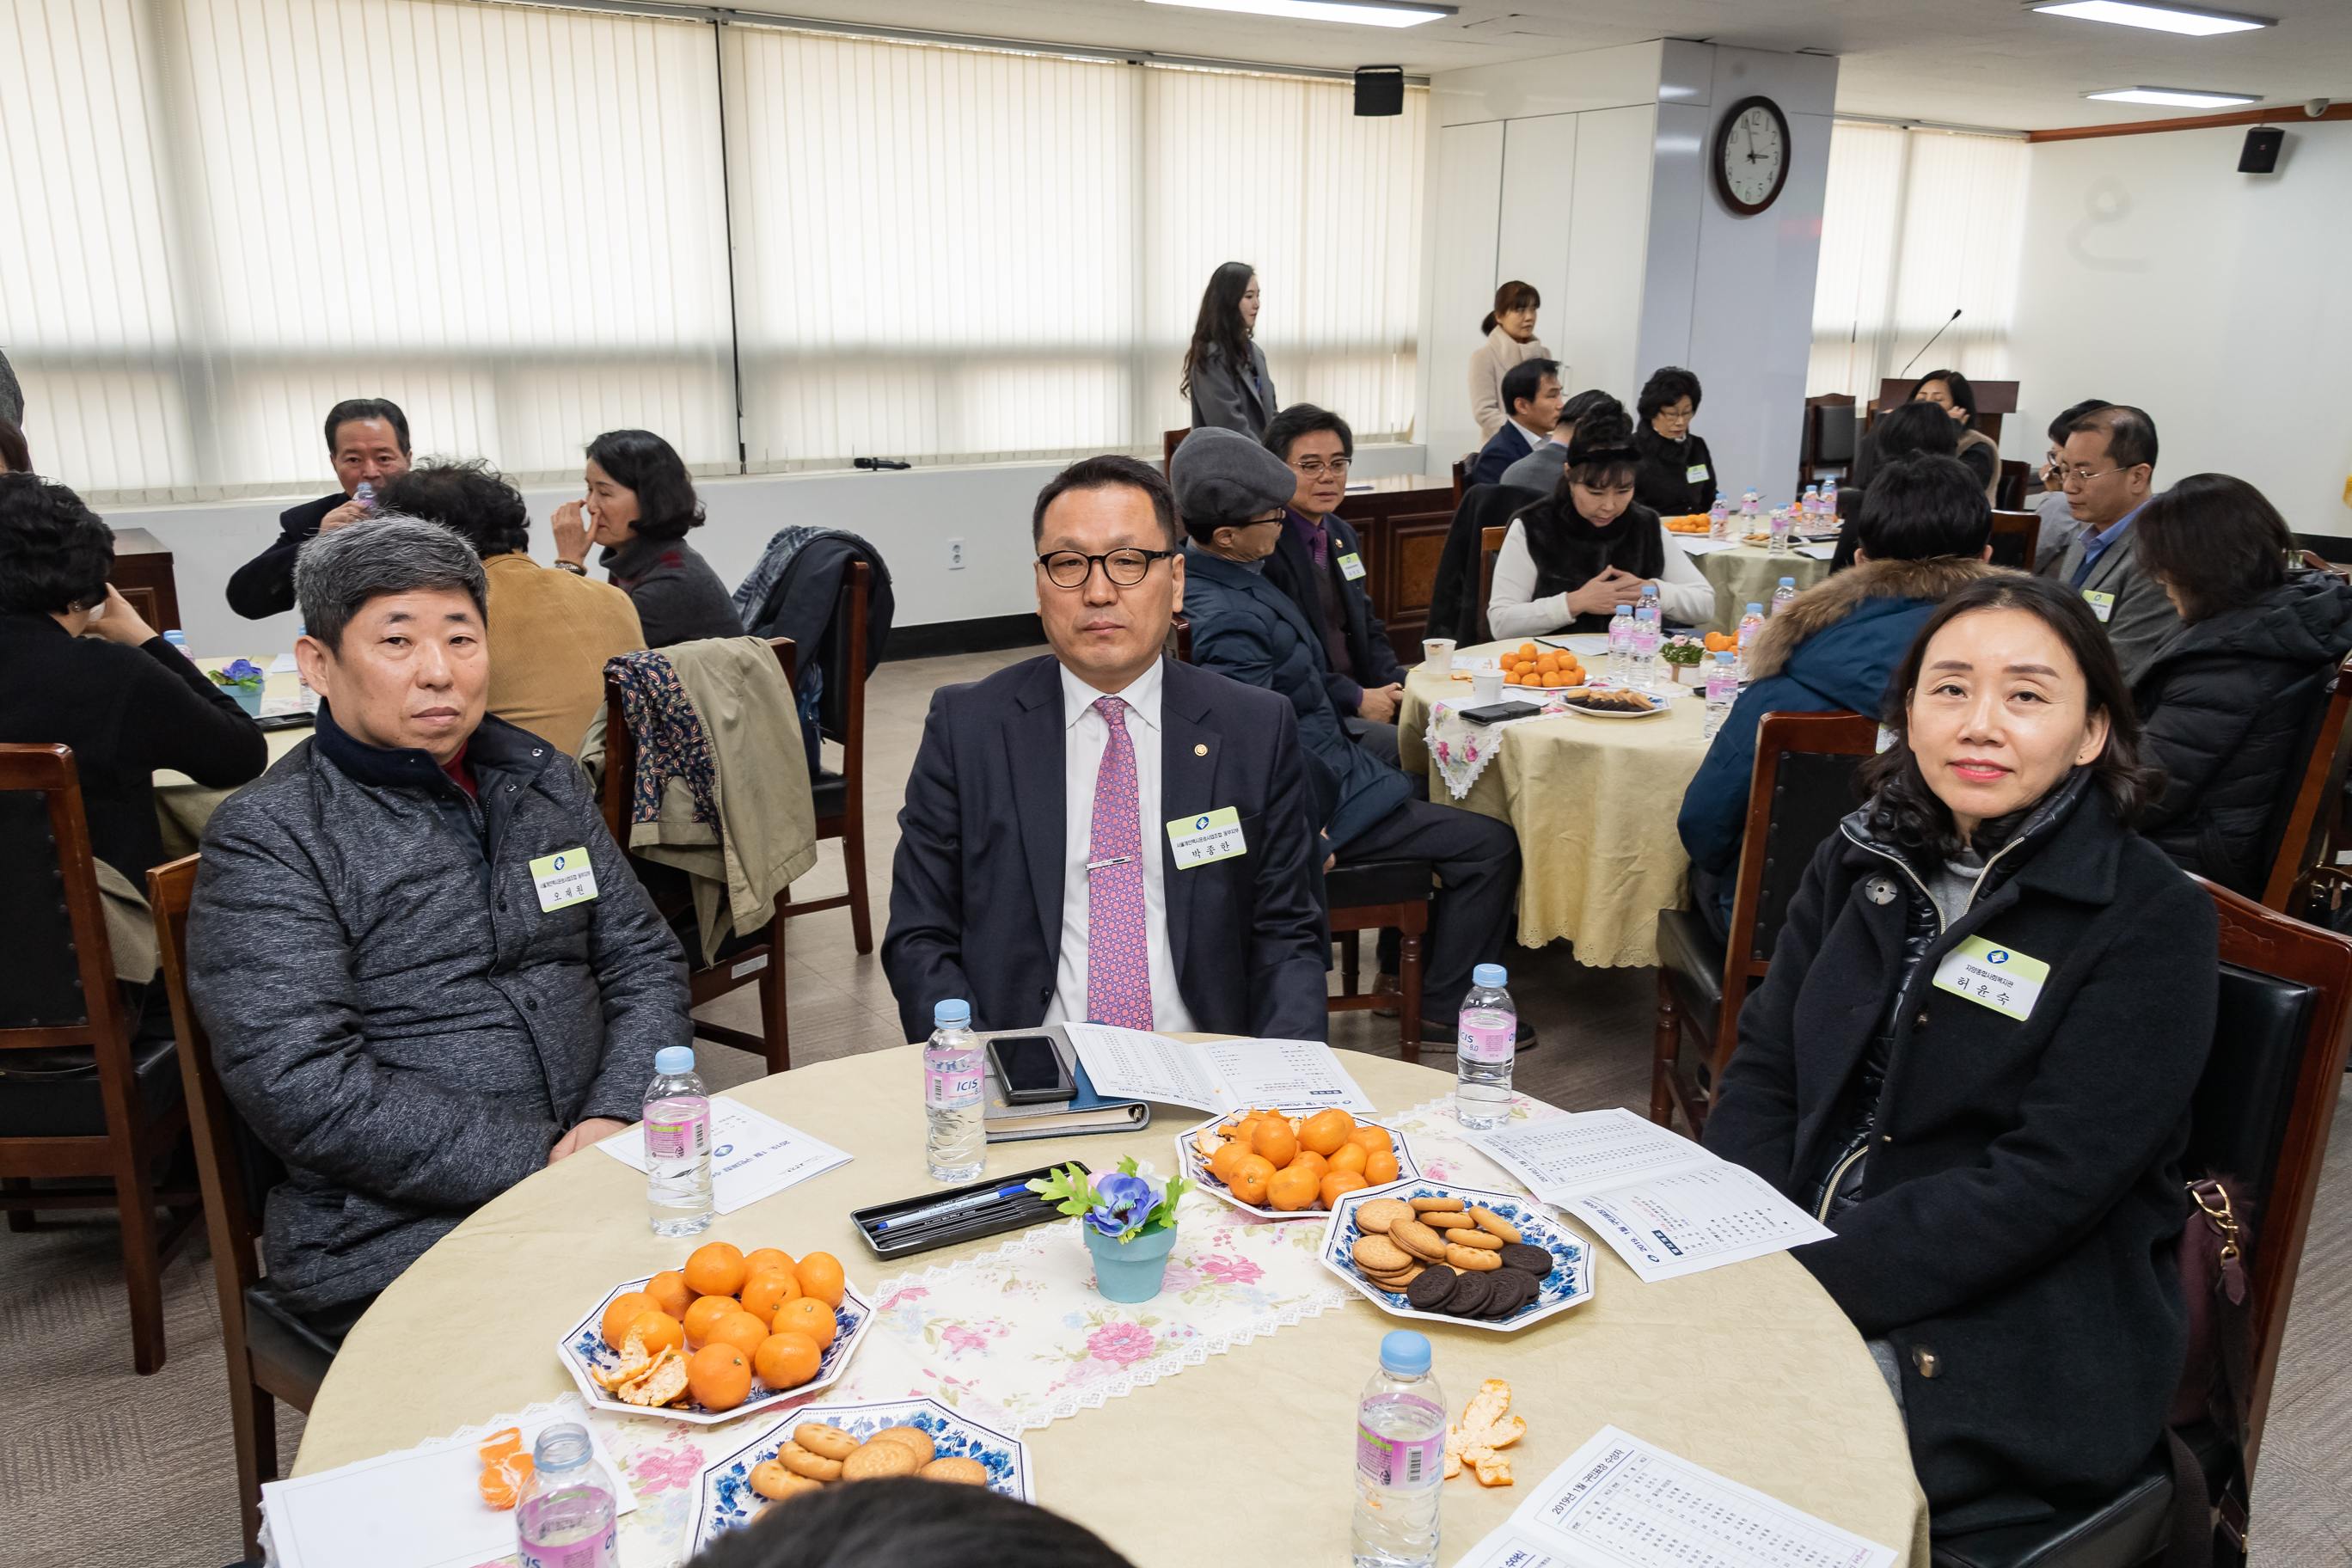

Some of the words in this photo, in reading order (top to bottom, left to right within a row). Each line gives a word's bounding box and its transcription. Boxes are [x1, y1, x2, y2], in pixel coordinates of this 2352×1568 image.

[1751, 111, 1761, 126] 12
[1965, 965, 2014, 988] 자양종합사회복지관
[957, 1079, 977, 1091] ICIS
[1631, 1237, 1651, 1252] 2019.
[1552, 1492, 1577, 1515] 2019년
[1573, 1482, 1587, 1492] 1월
[1582, 1463, 1608, 1482] 구민표창
[1605, 1449, 1625, 1463] 수상자
